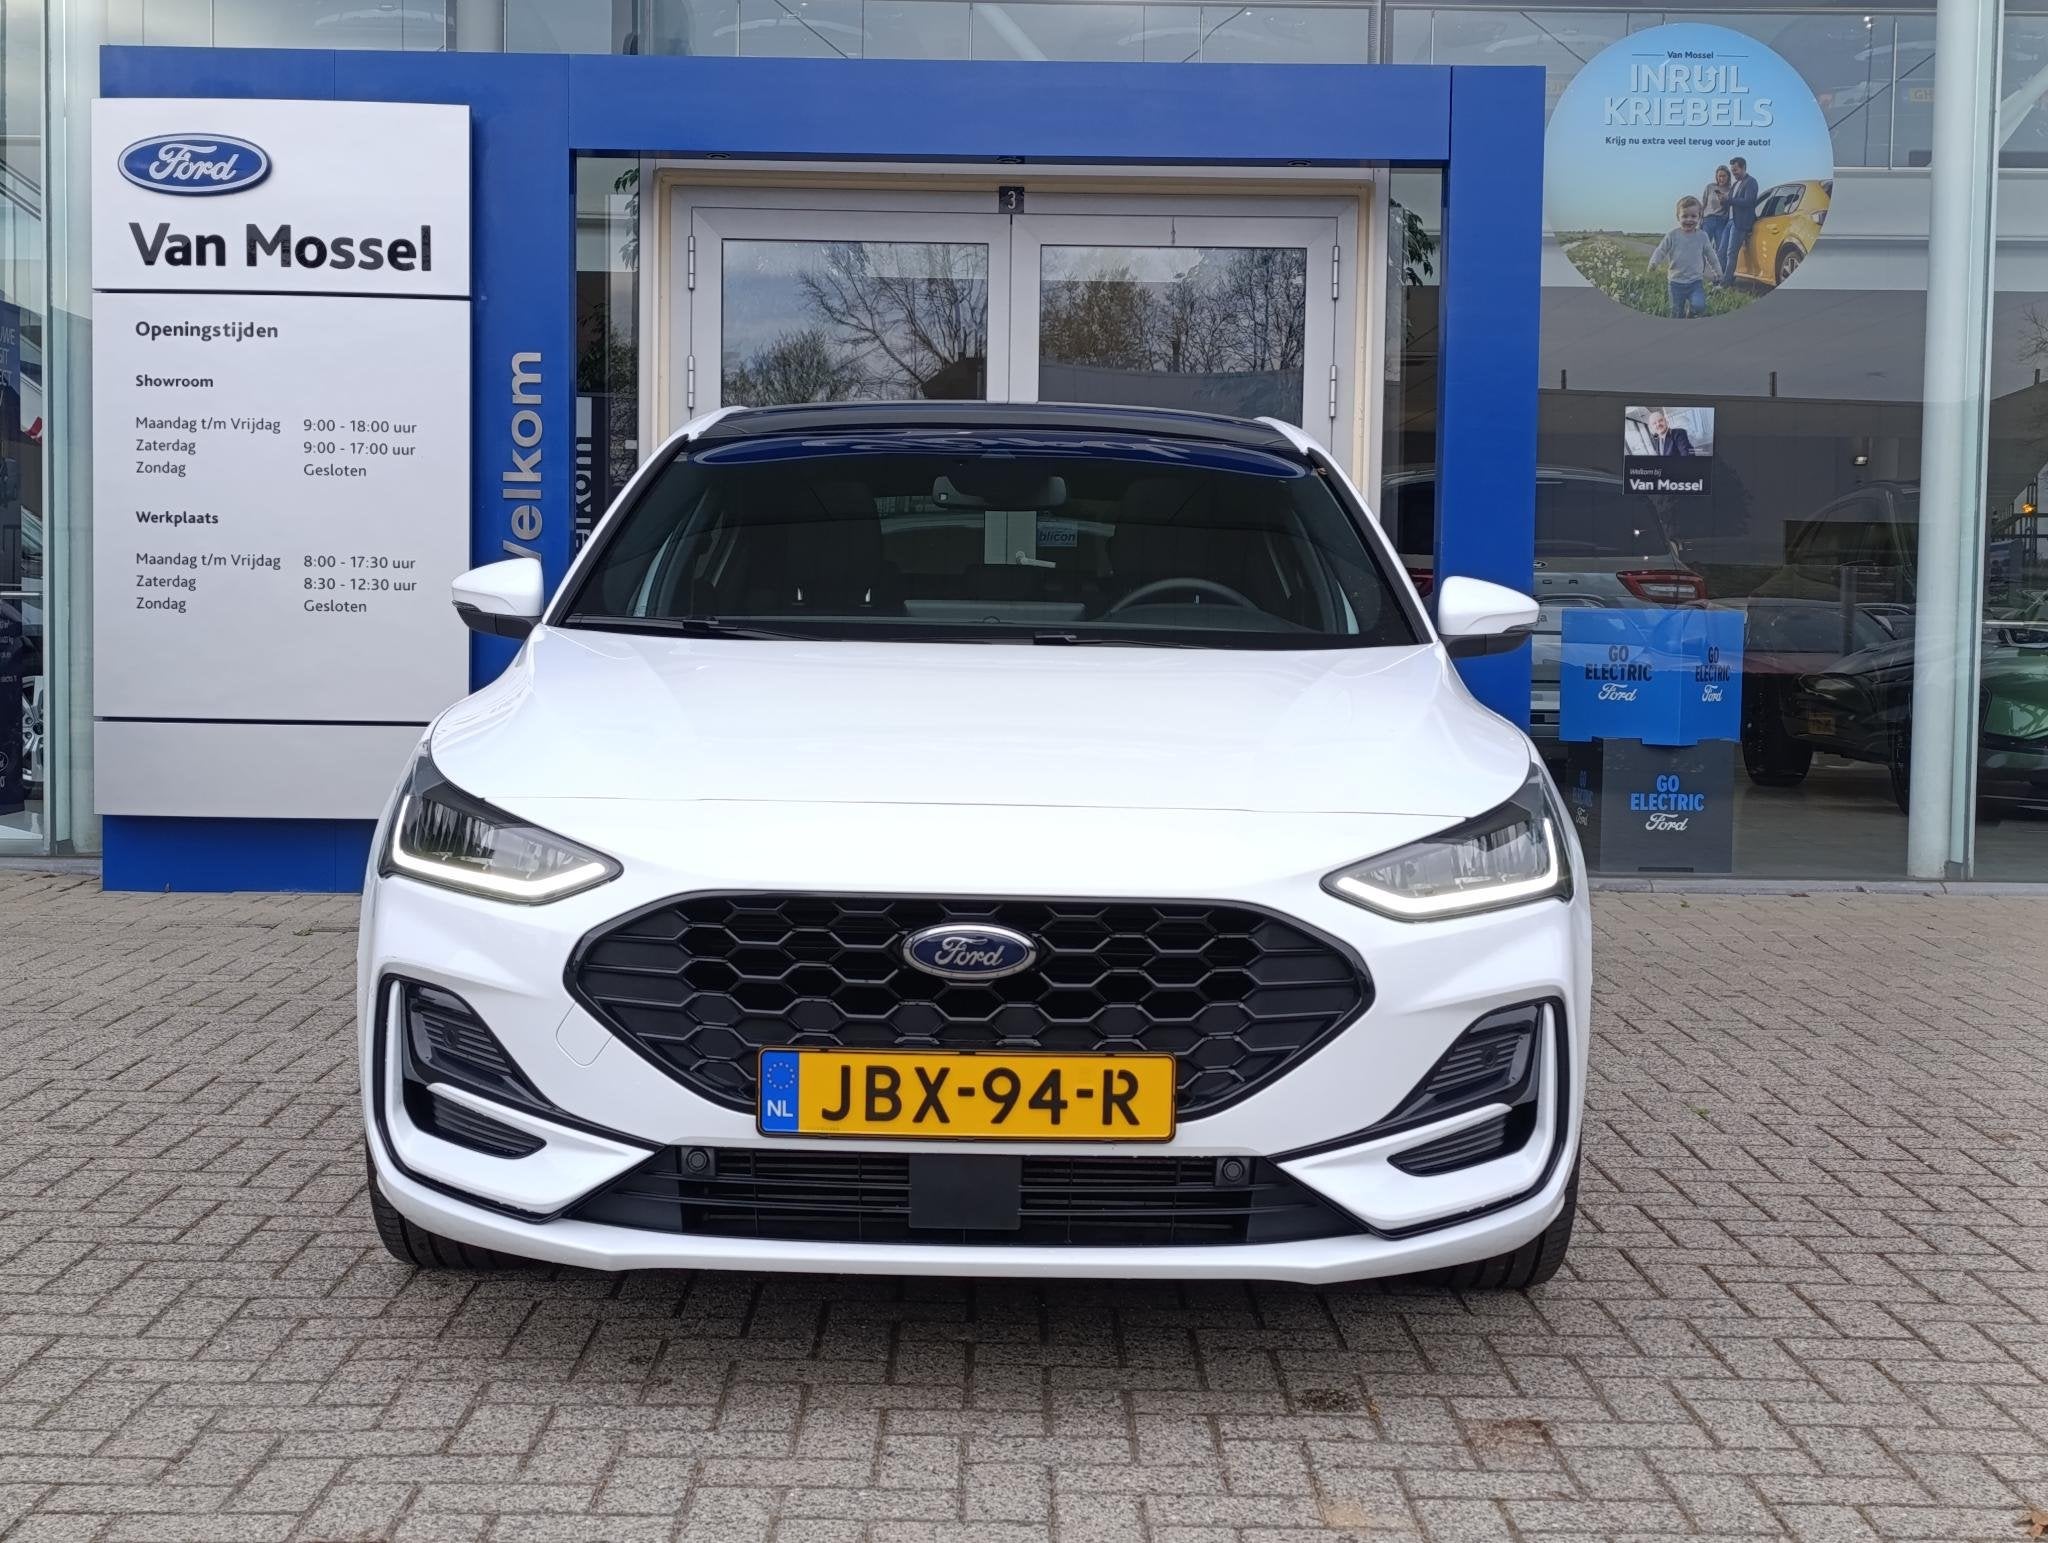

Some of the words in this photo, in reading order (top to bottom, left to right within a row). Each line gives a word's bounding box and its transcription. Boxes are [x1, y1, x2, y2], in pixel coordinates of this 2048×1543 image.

[1667, 51, 1682, 59] Van
[1685, 51, 1714, 59] Mossel
[1630, 63, 1750, 94] INRUIL
[1604, 97, 1774, 127] KRIEBELS
[1605, 136, 1626, 146] Krijg
[1641, 137, 1666, 145] extra
[1667, 137, 1686, 145] veel
[1688, 137, 1713, 147] terug
[1715, 138, 1736, 146] voor
[1736, 138, 1745, 147] je
[1747, 138, 1771, 147] auto!
[148, 142, 238, 182] Ford
[1007, 190, 1016, 210] 3
[128, 222, 226, 266] Van
[246, 224, 432, 272] Mossel
[135, 321, 279, 342] Openingstijden
[135, 374, 214, 388] Showroom
[136, 417, 197, 432] Maandag
[201, 417, 227, 430] t/m
[230, 418, 281, 434] Vrijdag
[303, 419, 336, 432] 9:00
[350, 420, 389, 433] 18:00
[393, 424, 417, 434] uur
[136, 439, 196, 455] Zaterdag
[303, 442, 336, 454] 9:00
[350, 443, 388, 455] 17:00
[392, 446, 416, 456] uur
[136, 461, 186, 477] Zondag
[303, 463, 367, 477] Gesloten
[1629, 479, 1654, 491] Van
[1657, 479, 1703, 491] Mossel
[136, 511, 219, 527] Werkplaats
[136, 553, 197, 569] Maandag
[201, 553, 227, 566] t/m
[231, 554, 281, 570] Vrijdag
[303, 555, 336, 568] 8:00
[350, 556, 388, 569] 17:30
[392, 559, 416, 569] uur
[136, 575, 197, 591] Zaterdag
[303, 578, 336, 590] 8:30
[350, 578, 389, 591] 12:30
[393, 580, 417, 591] uur
[136, 597, 187, 613] Zondag
[303, 599, 367, 613] Gesloten
[1608, 645, 1629, 662] GO
[1708, 647, 1720, 663] GO
[1585, 664, 1653, 681] ELECTRIC
[1695, 665, 1730, 682] ELECTRIC
[1598, 682, 1638, 701] Ford
[1702, 684, 1723, 702] Ford
[1656, 774, 1680, 792] GO
[1630, 793, 1705, 811] ELECTRIC
[1645, 812, 1689, 831] Ford
[934, 936, 1005, 966] Ford
[821, 1064, 1140, 1126] JBX-94-R
[767, 1099, 794, 1118] NL
